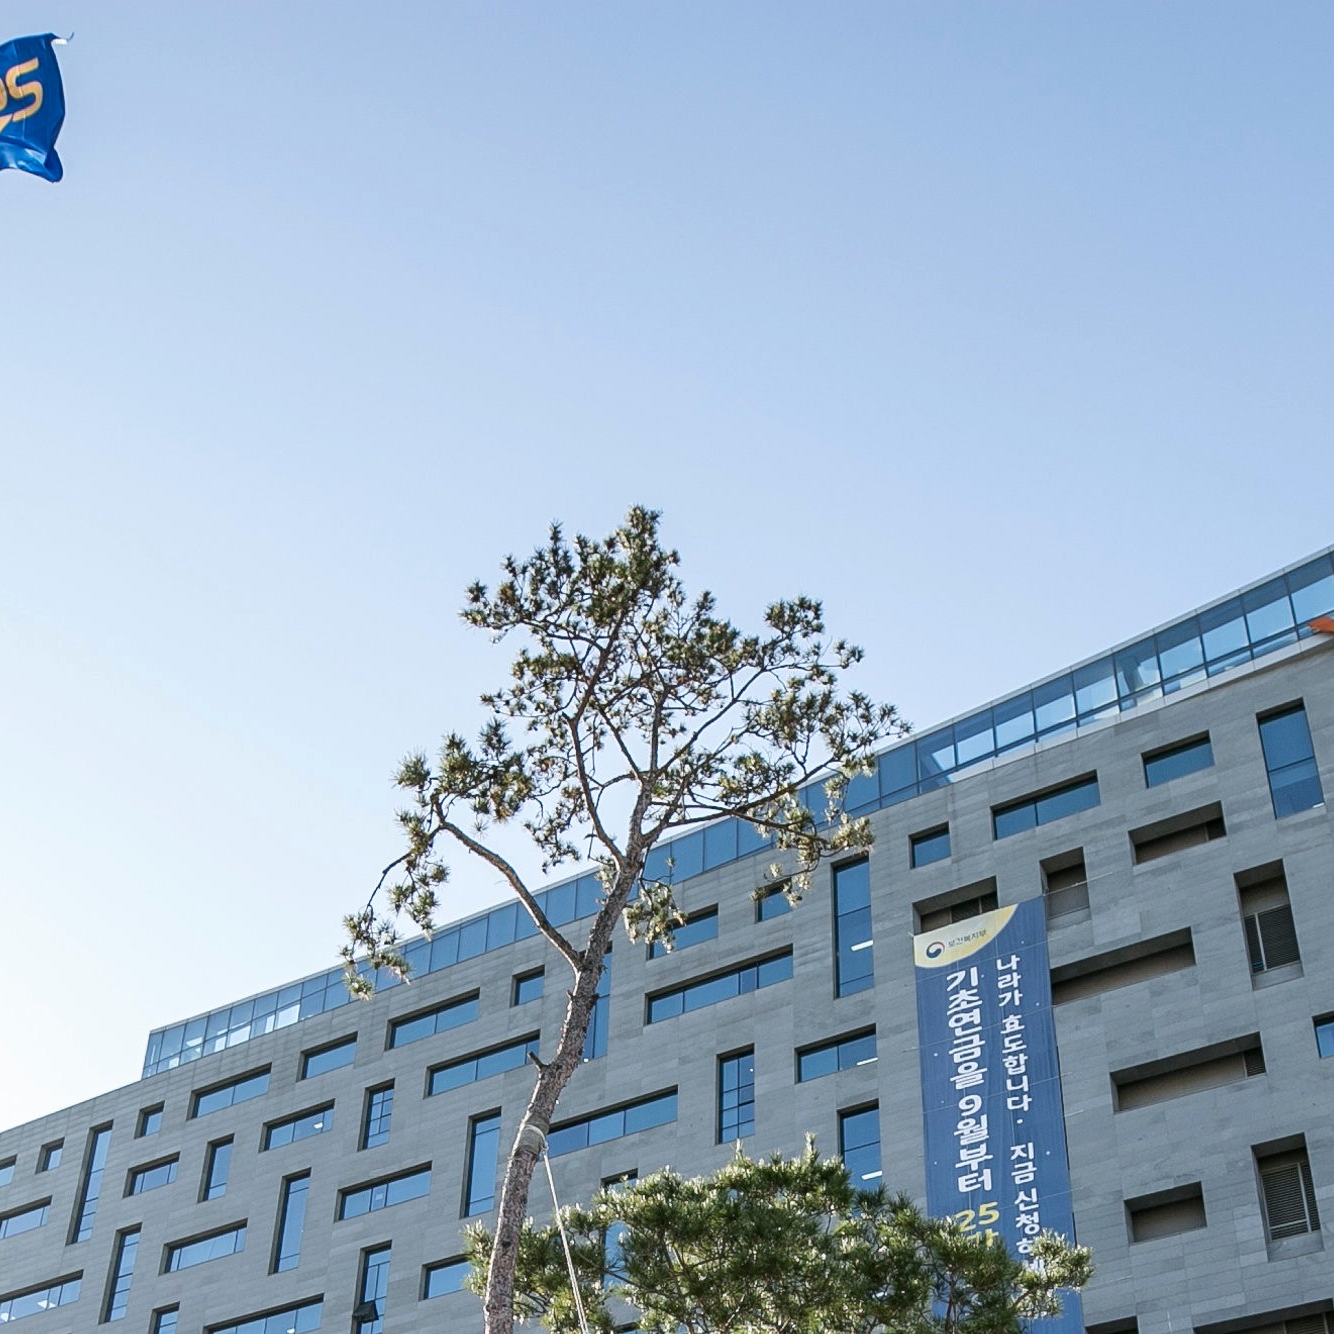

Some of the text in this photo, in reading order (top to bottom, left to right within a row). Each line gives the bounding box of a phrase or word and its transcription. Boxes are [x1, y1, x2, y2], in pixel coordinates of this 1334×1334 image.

[946, 966, 987, 1090] 기초연금을
[997, 954, 1023, 1007] 나라가
[1010, 1142, 1037, 1185] 지금
[953, 1094, 993, 1193] 9월부터
